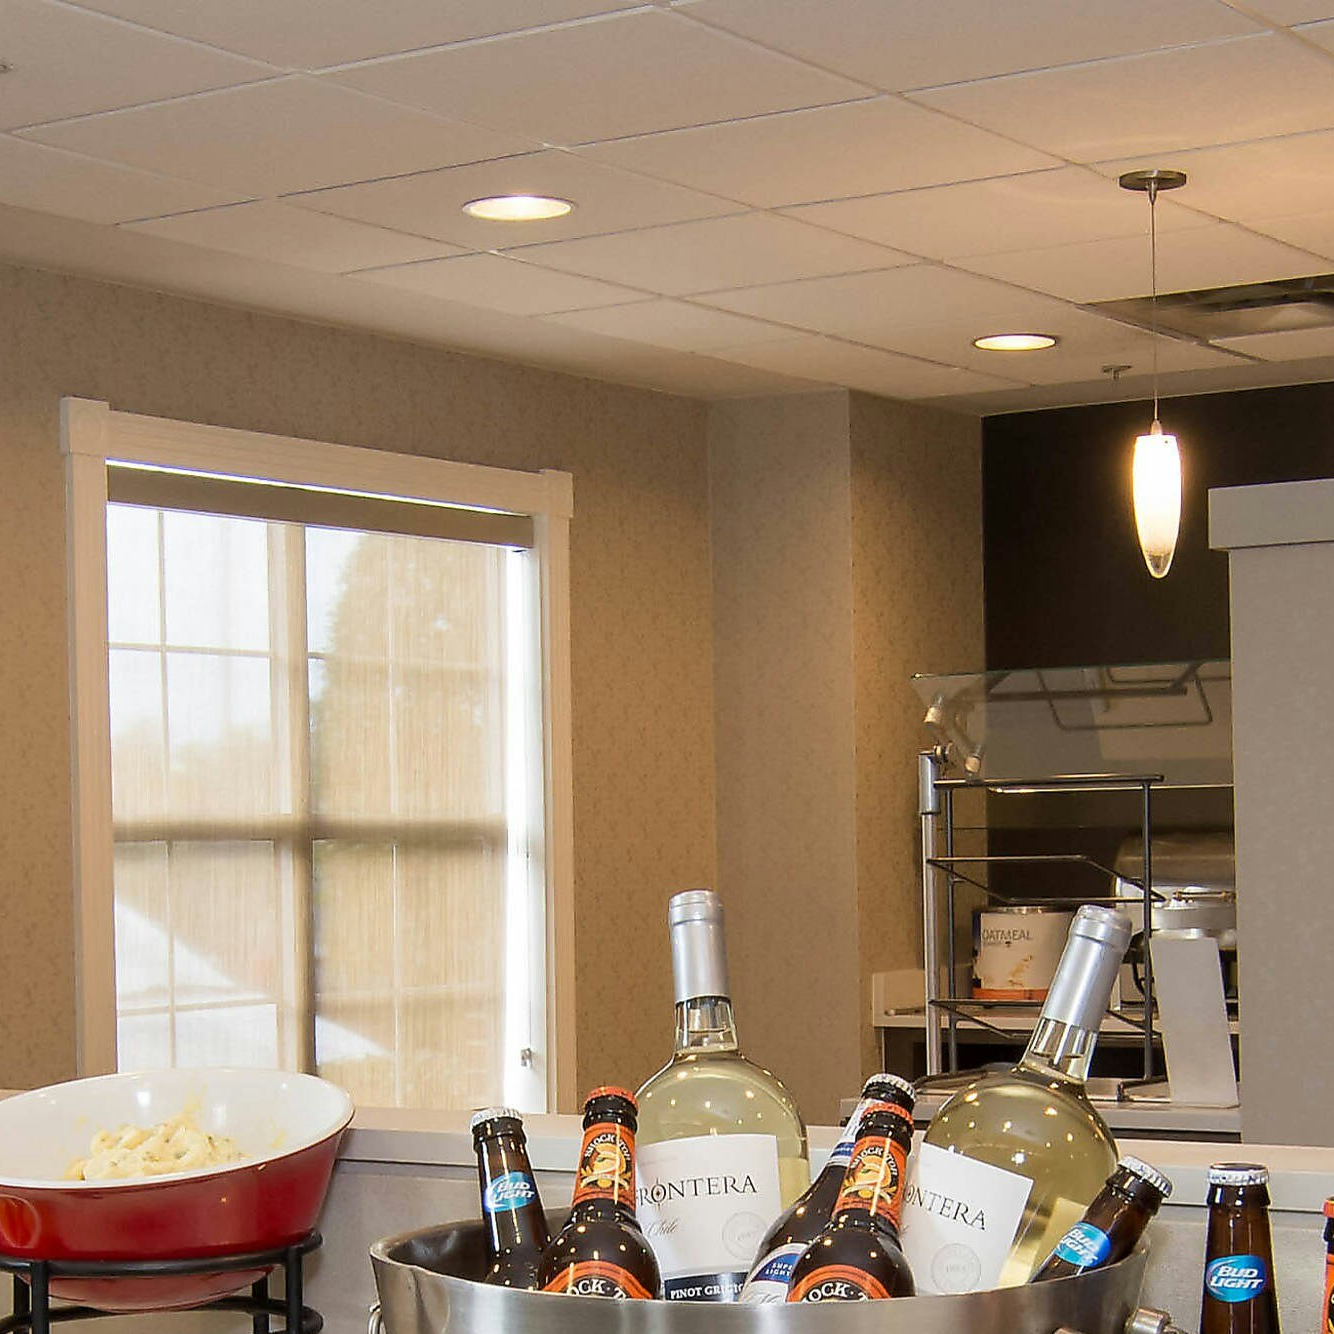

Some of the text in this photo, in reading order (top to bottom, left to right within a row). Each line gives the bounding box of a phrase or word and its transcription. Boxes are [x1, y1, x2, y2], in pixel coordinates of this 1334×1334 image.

[981, 928, 1033, 941] OATMEAL
[636, 1174, 757, 1206] RONTERA
[903, 1185, 987, 1230] ONTERA
[1218, 1266, 1259, 1279] BUD
[1210, 1275, 1264, 1290] LIGHT
[670, 1286, 702, 1300] PINOT
